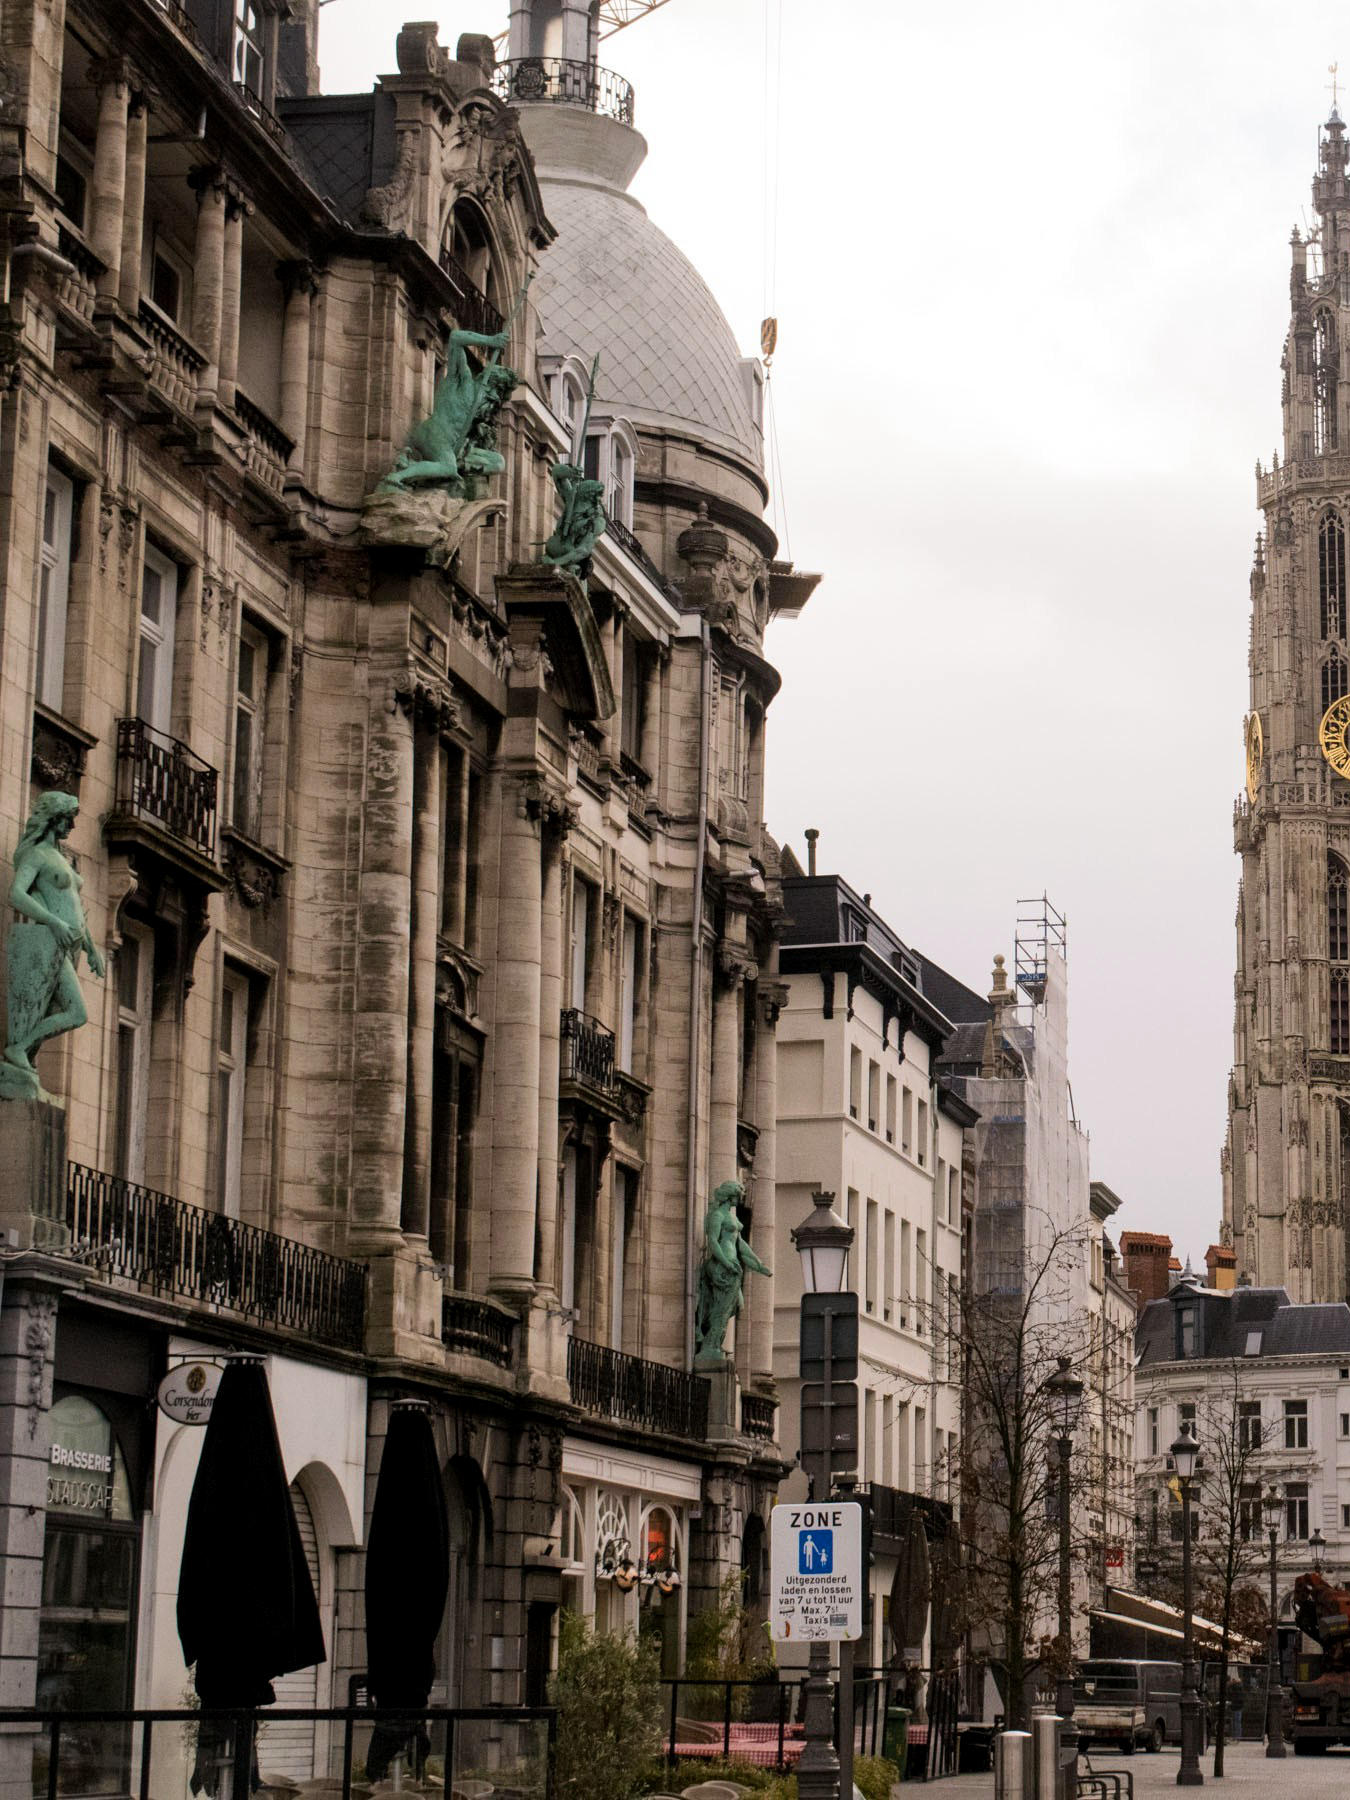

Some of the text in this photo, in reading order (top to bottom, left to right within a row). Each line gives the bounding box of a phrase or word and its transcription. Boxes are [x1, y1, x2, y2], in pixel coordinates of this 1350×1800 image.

[164, 1388, 214, 1407] Corsendo
[186, 1406, 202, 1421] bier
[51, 1444, 112, 1473] BRASSERIE
[790, 1511, 842, 1528] ZONE
[786, 1574, 847, 1586] Uitgezonderd
[781, 1586, 806, 1595] laden
[821, 1586, 852, 1594] lossen
[779, 1597, 795, 1605] van
[797, 1595, 803, 1605] 7
[813, 1596, 827, 1604] tot
[830, 1595, 836, 1604] 11
[838, 1596, 854, 1604] uur
[801, 1605, 822, 1615] Max.
[804, 1615, 829, 1625] Taxi's
